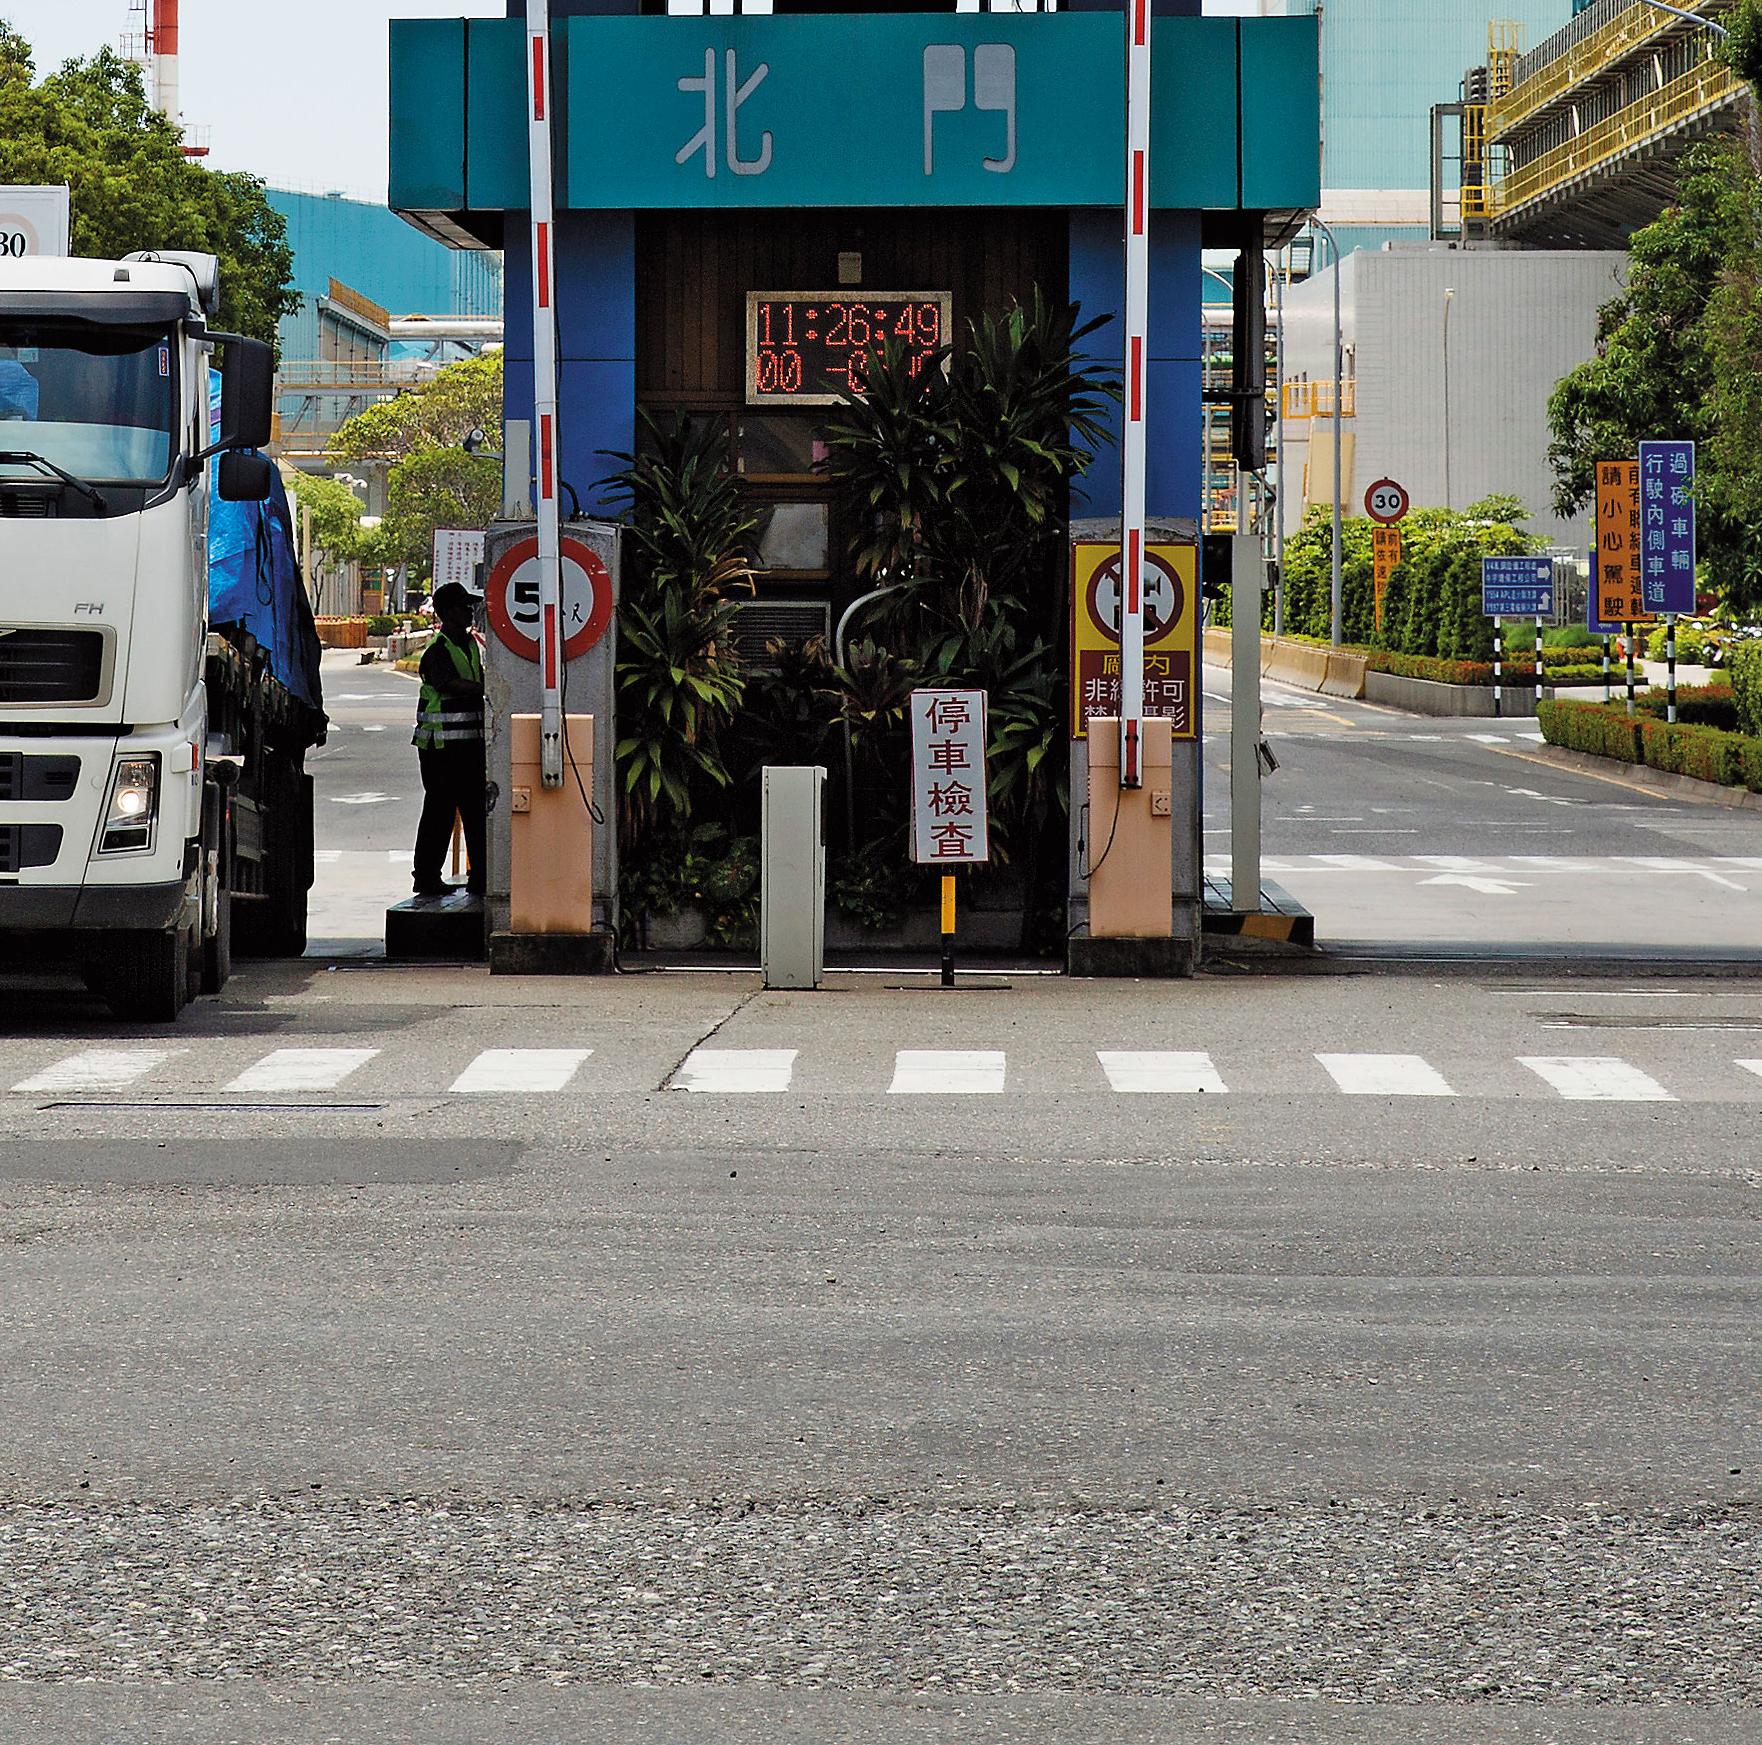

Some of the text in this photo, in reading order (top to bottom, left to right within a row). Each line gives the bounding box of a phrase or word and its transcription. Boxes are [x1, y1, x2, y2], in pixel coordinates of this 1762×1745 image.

[675, 43, 1016, 179] 北門
[760, 303, 939, 346] 11:26:49
[1375, 494, 1401, 509] 30
[1602, 466, 1623, 617] 請小心駕駛
[1646, 453, 1665, 603] 行駛內側車道
[74, 602, 105, 615] FH
[925, 696, 975, 858] 停車檢查
